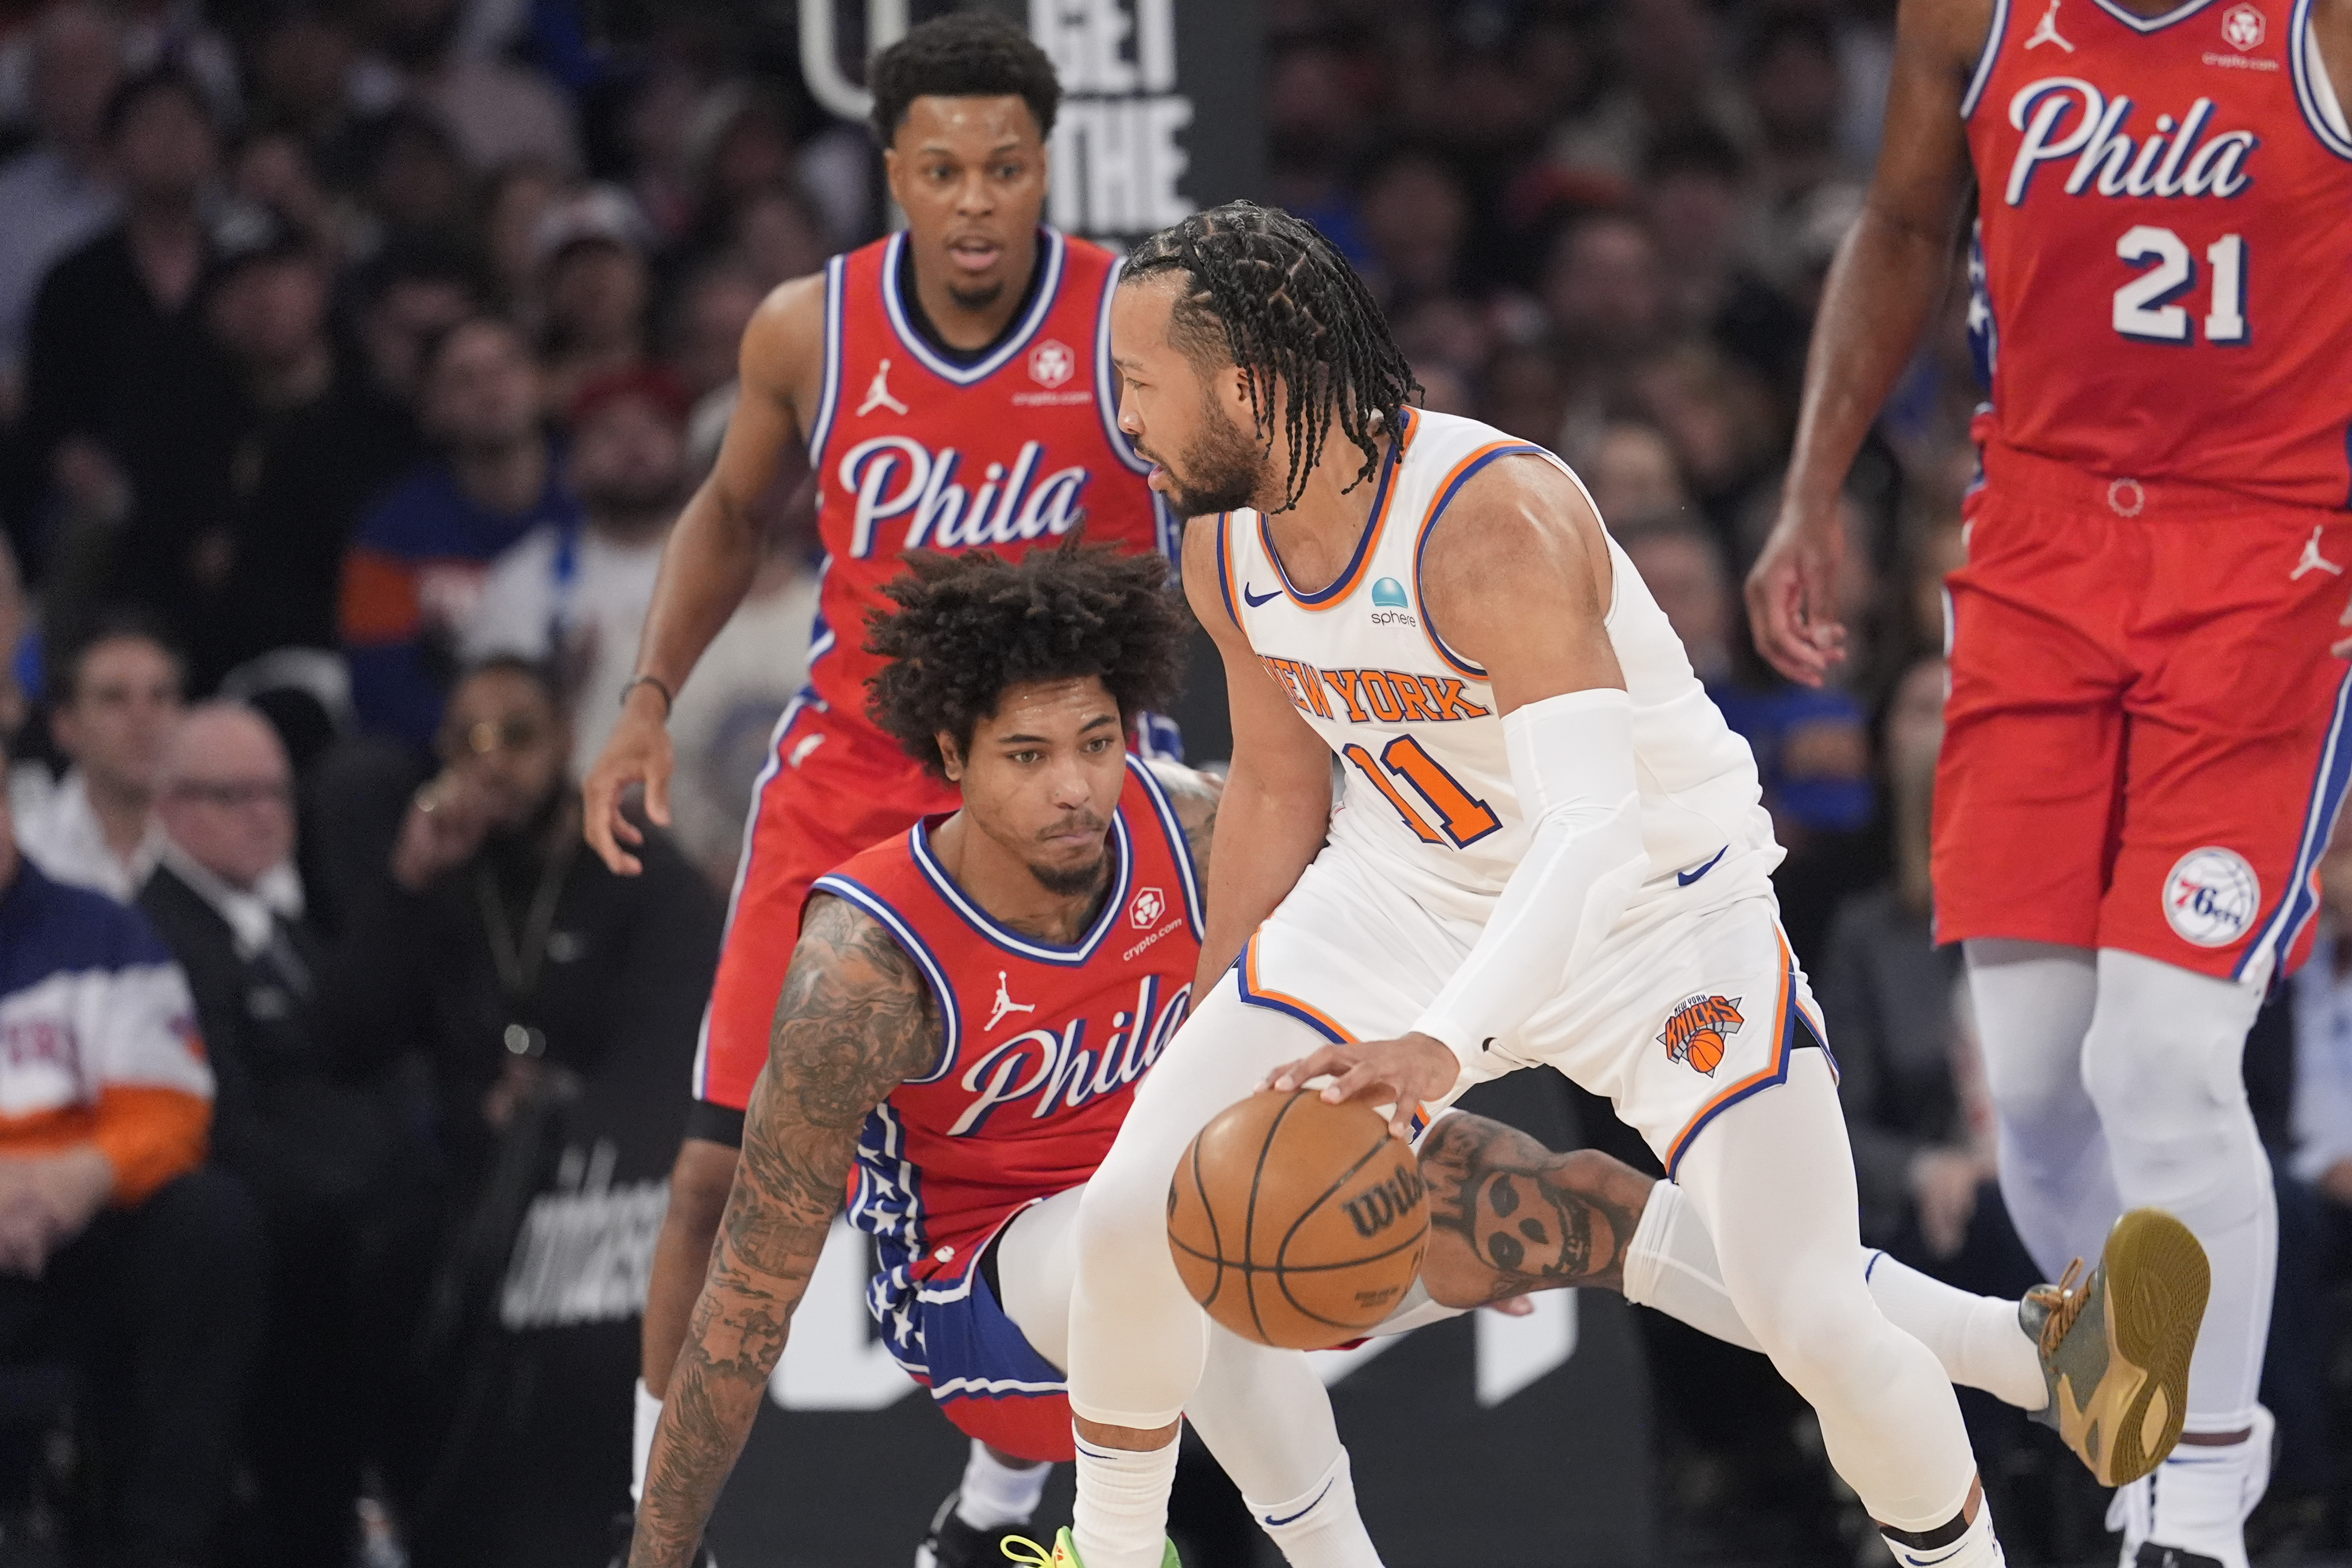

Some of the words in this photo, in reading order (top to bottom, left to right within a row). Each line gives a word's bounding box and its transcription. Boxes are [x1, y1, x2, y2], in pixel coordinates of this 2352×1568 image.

[2004, 77, 2259, 207] Phila
[2113, 225, 2252, 346] 21
[838, 435, 1090, 558] Phila
[1371, 610, 1416, 627] sphere
[1319, 667, 1494, 724] YORK
[1342, 733, 1503, 851] 11
[1122, 918, 1182, 962] crypto.com
[1665, 995, 1745, 1064] KNICKS
[1674, 1001, 1688, 1016] NEW
[1687, 994, 1707, 1006] YORK
